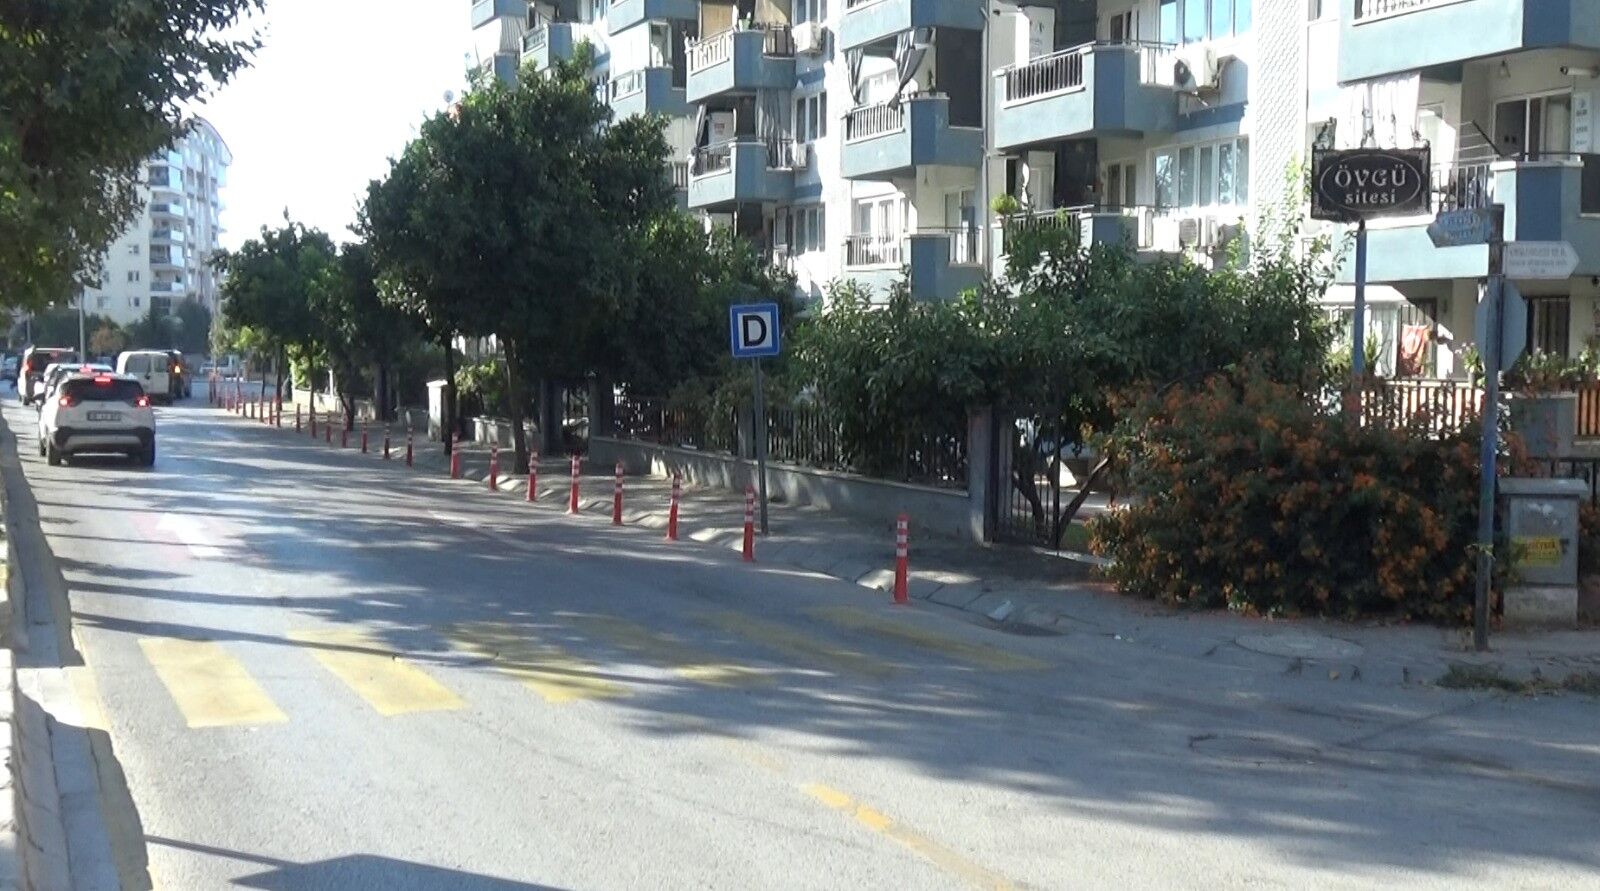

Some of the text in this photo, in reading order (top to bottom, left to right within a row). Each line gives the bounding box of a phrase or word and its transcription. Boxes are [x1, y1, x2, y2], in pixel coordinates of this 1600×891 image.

[1334, 164, 1406, 187] ÖVGÜ
[1345, 188, 1396, 204] sitesi
[742, 314, 767, 347] D
